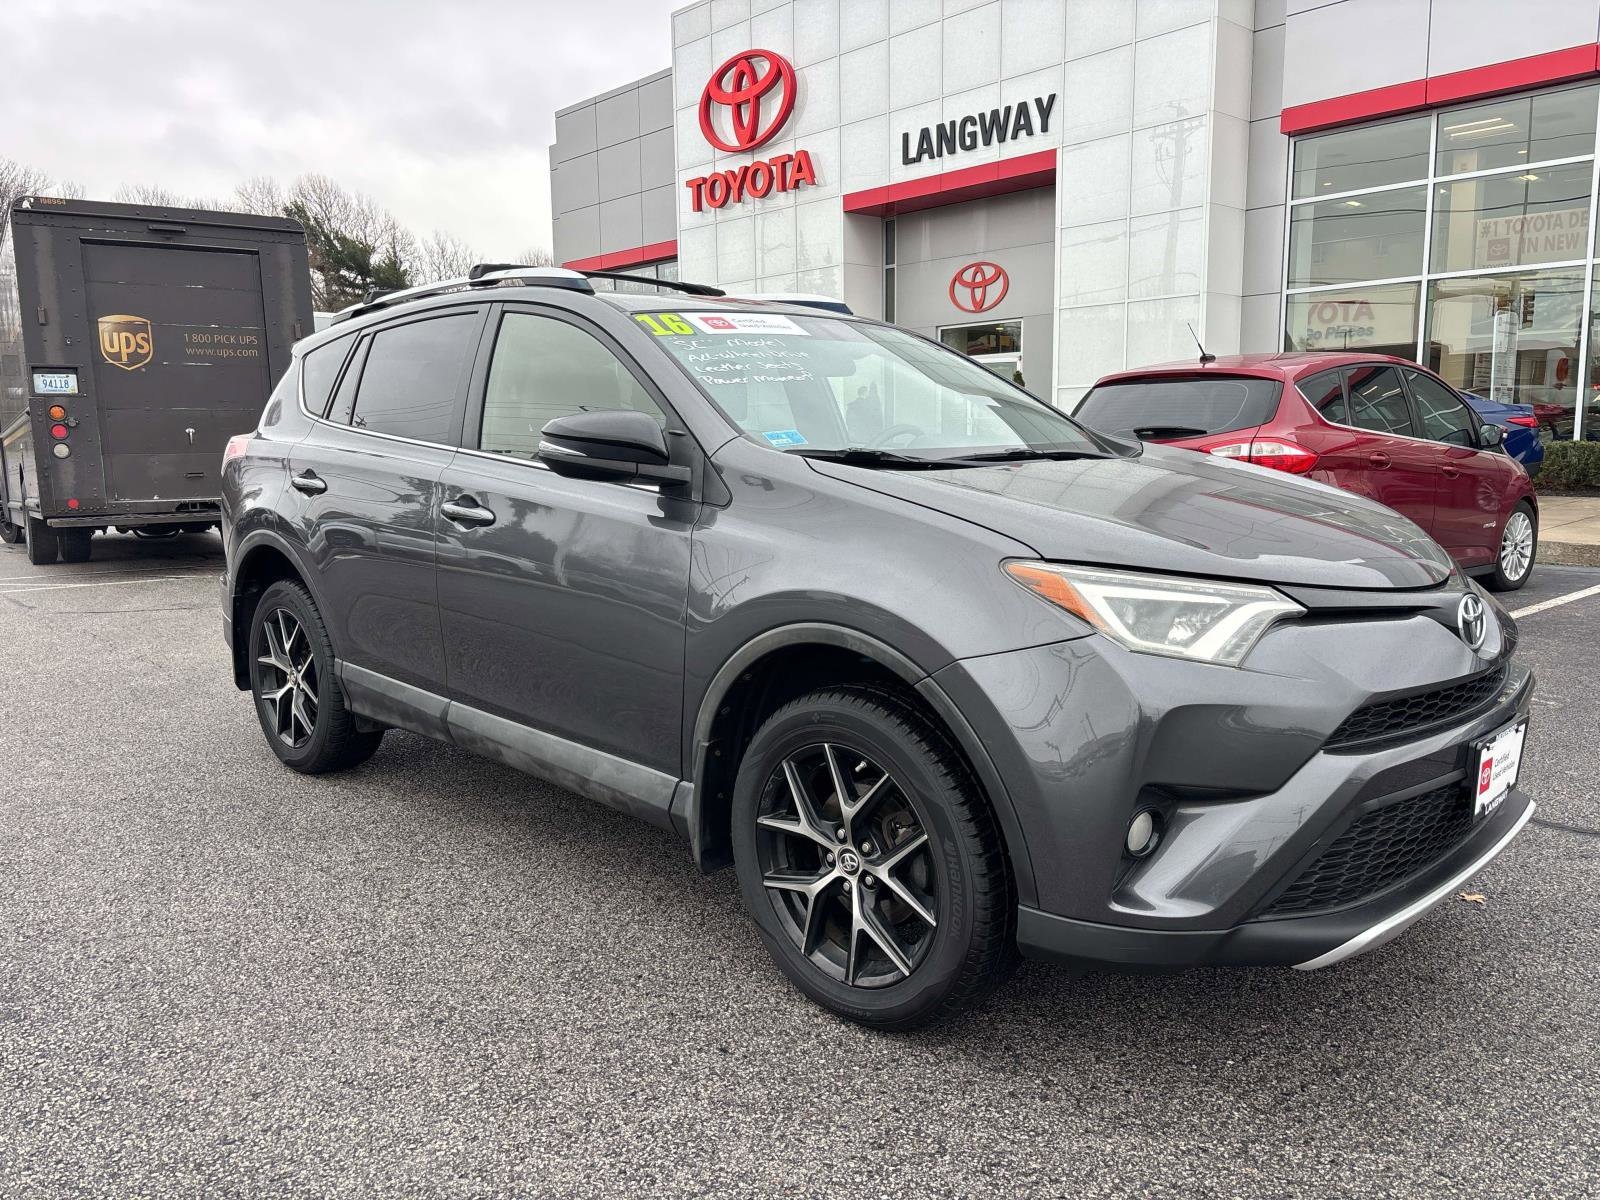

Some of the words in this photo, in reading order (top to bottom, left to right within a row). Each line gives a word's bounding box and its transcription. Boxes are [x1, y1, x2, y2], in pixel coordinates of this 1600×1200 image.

[901, 93, 1057, 165] LANGWAY
[686, 150, 816, 212] TOYOTA
[1504, 213, 1563, 236] TOYOTA
[1522, 237, 1539, 254] IN
[1544, 231, 1580, 252] NEW
[635, 313, 695, 336] 16
[103, 331, 150, 362] ups
[191, 334, 211, 343] 800
[214, 334, 236, 344] PICK
[239, 336, 258, 345] UPS
[185, 346, 258, 358] www.ups.com
[42, 378, 70, 389] 94118
